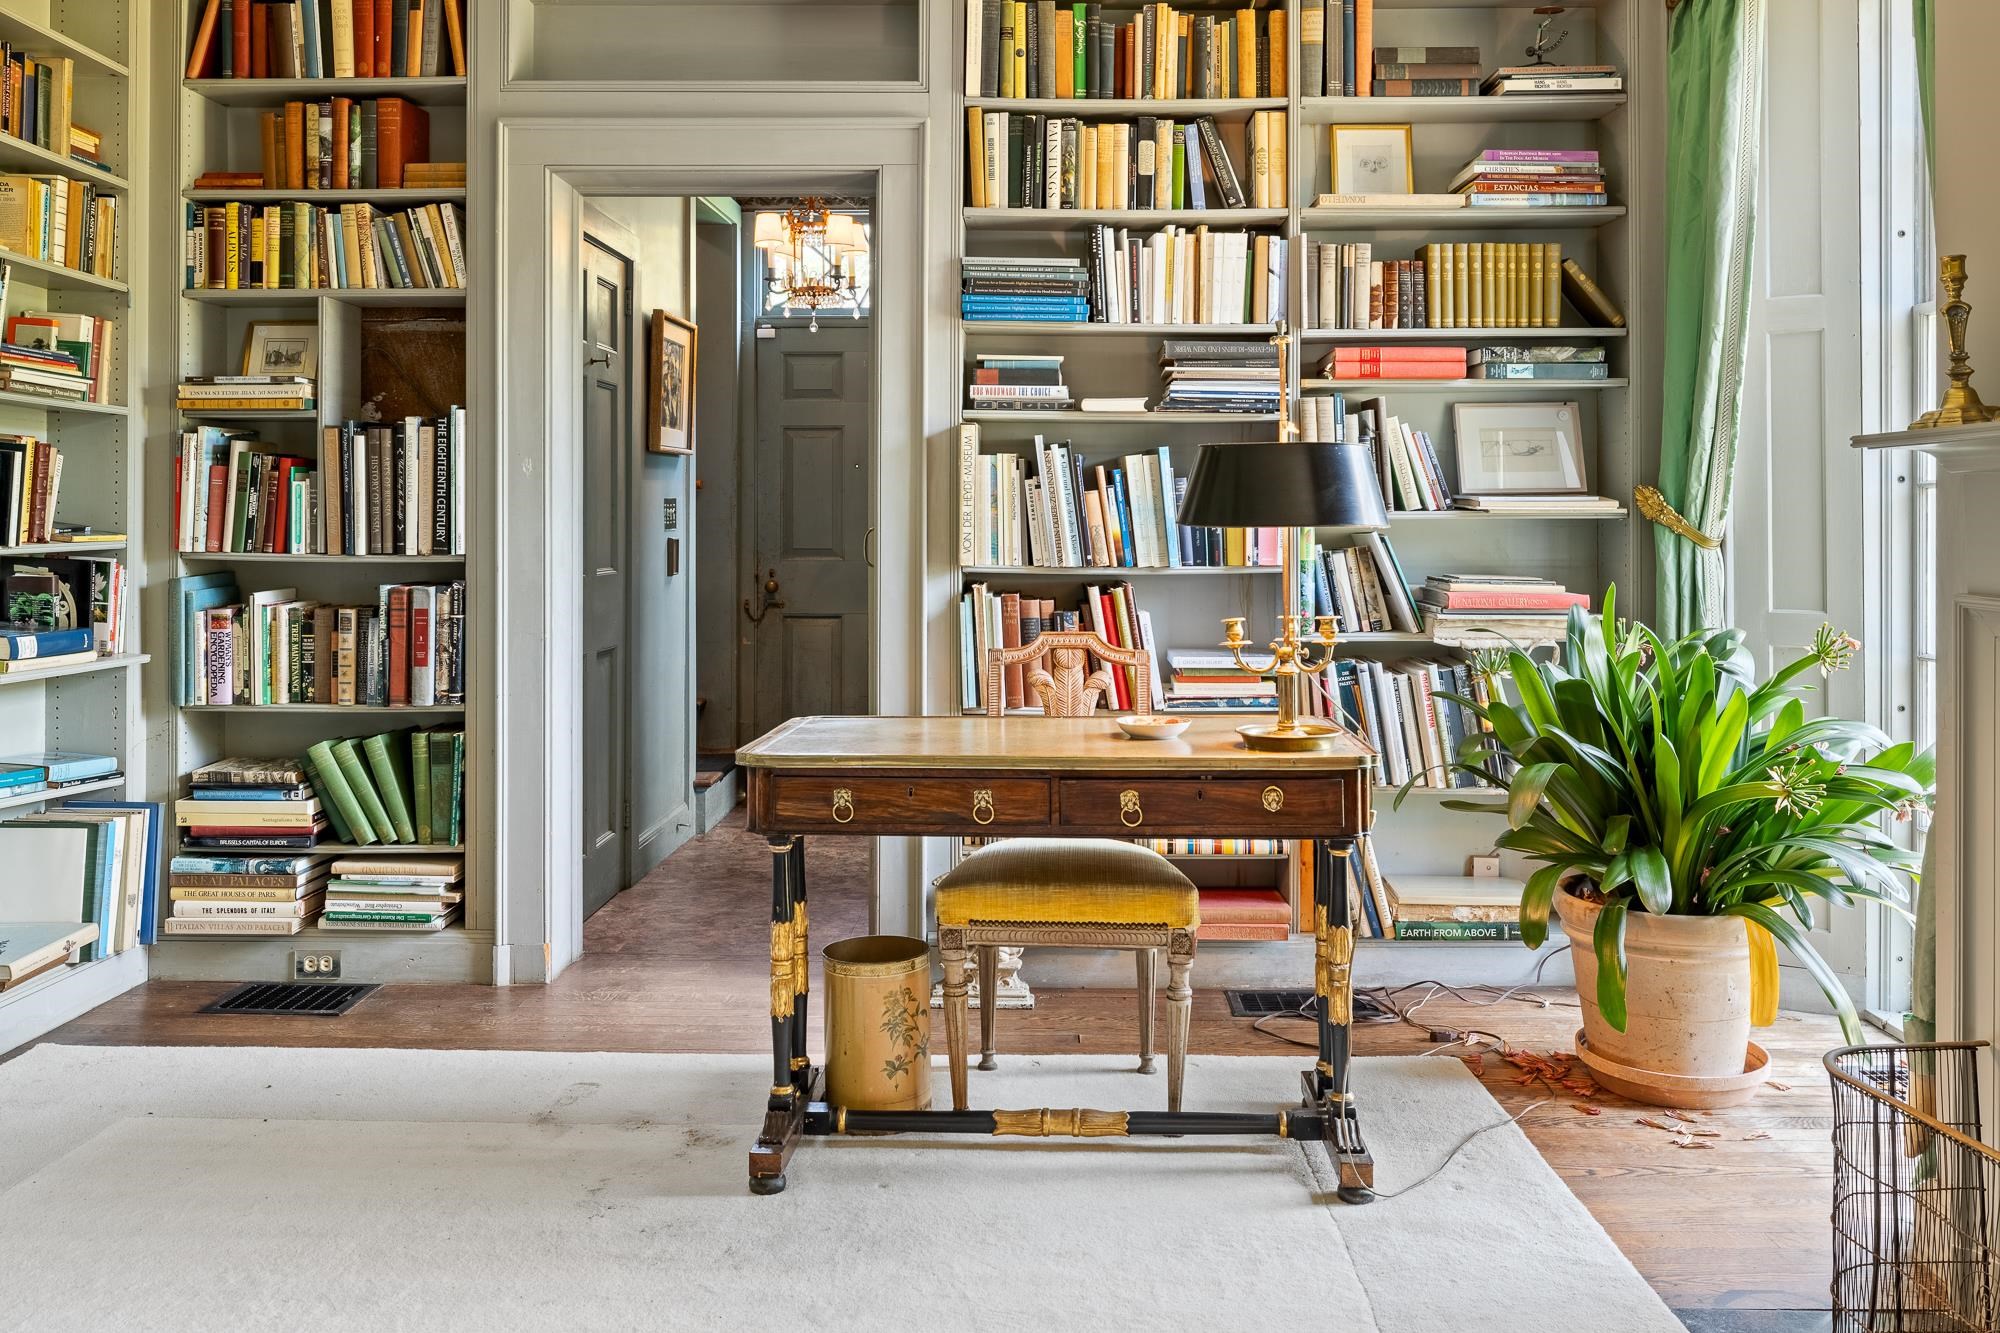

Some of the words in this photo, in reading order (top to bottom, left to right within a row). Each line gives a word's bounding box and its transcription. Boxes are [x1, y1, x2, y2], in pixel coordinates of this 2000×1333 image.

[1048, 122, 1058, 199] PAINTINGS
[228, 230, 237, 273] ALPINES
[1174, 345, 1191, 353] WERK
[972, 387, 984, 396] BOB
[985, 387, 1017, 396] WOODWARD
[1018, 387, 1028, 396] THE
[1030, 387, 1051, 396] CHOICE
[438, 417, 447, 437] THE
[371, 456, 379, 491] HISTORY
[436, 438, 447, 496] EIGHTEENTH
[963, 435, 973, 507] HEYDT-MUSEUM
[1399, 463, 1412, 496] RUSSELL
[383, 477, 391, 488] OF
[372, 493, 379, 505] OF
[372, 507, 380, 533] RUSSIA
[436, 498, 446, 543] CENTURY
[963, 511, 972, 528] DER
[963, 532, 972, 554] VON
[291, 623, 299, 642] TREE
[210, 632, 218, 698] ENCYCLOPEDIA
[218, 632, 226, 685] GARDENING
[291, 643, 300, 694] MAINTENANCE
[1425, 701, 1435, 729] WALTER
[181, 876, 226, 886] GREAT
[230, 876, 285, 886] PALACES
[1400, 928, 1431, 938] EARTH
[1434, 928, 1462, 938] FROM
[1464, 928, 1497, 938] ABOVE
